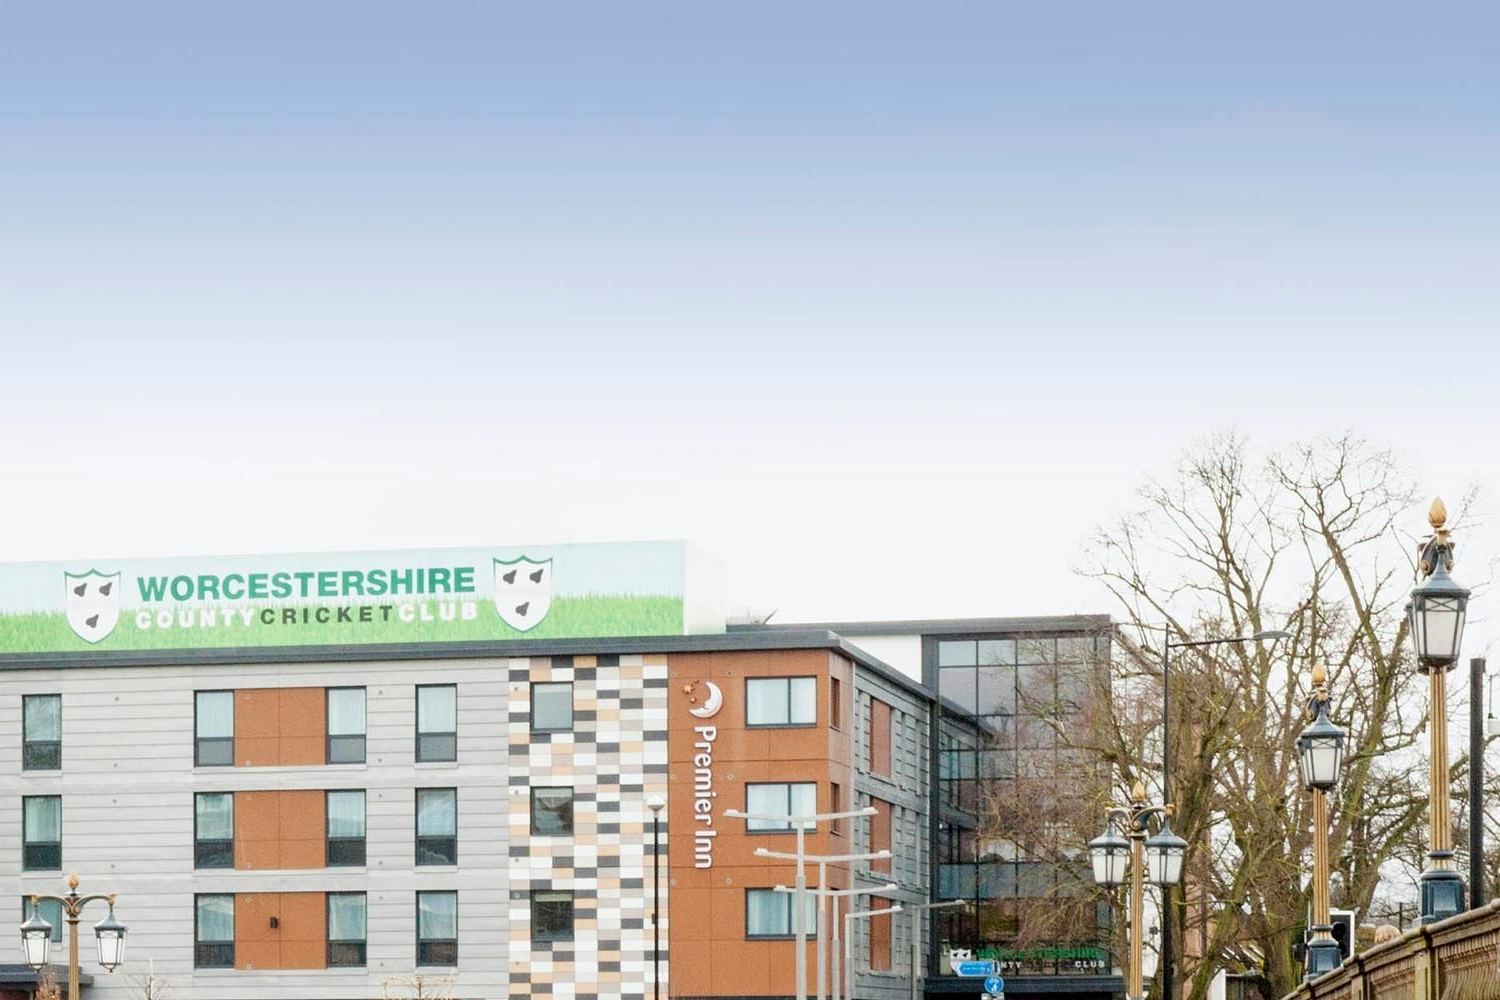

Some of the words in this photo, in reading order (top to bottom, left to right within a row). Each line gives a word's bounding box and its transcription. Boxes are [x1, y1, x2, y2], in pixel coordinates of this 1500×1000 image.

[137, 567, 476, 601] WORCESTERSHIRE
[135, 606, 255, 630] COUNTY
[260, 604, 394, 625] CRICKET
[398, 600, 478, 622] CLUB
[694, 725, 717, 826] Premier
[694, 830, 717, 869] Inn
